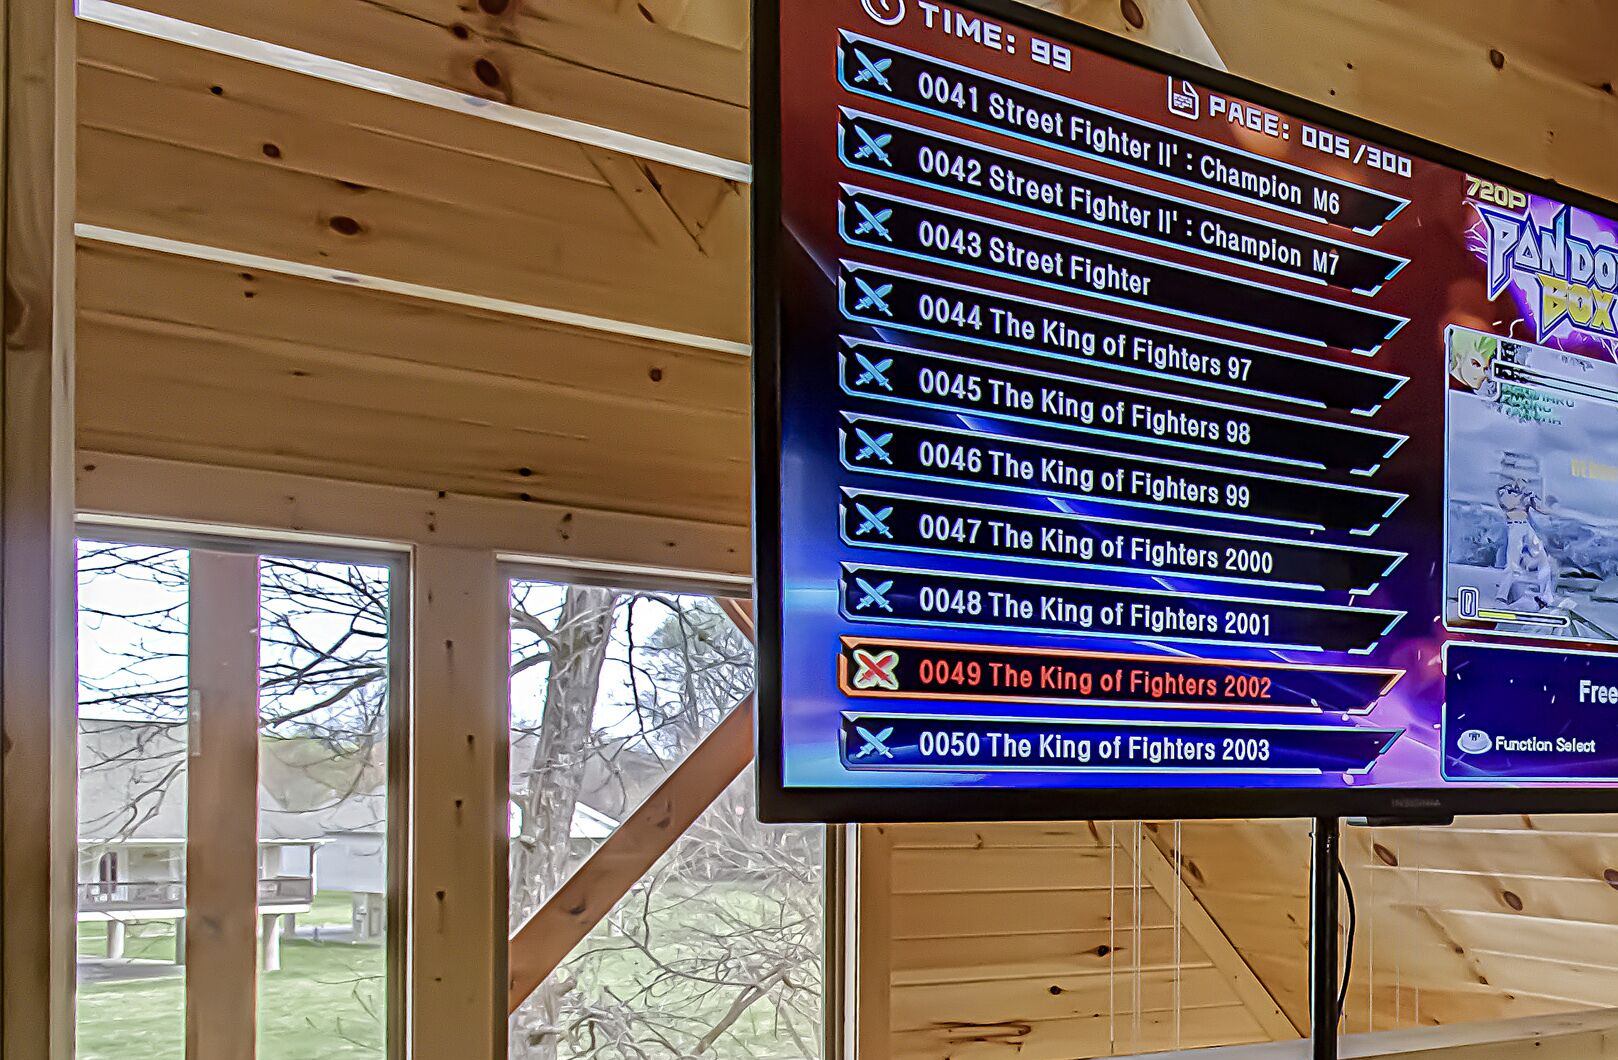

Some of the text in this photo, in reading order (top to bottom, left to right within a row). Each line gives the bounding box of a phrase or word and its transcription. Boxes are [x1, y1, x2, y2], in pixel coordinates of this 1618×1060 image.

[918, 1, 1071, 72] TIME: 99
[918, 72, 978, 113] 0041
[988, 92, 1064, 138] Street
[1071, 116, 1152, 161] Fighter
[1200, 155, 1302, 205] Champion
[1313, 187, 1340, 215] M6
[1209, 94, 1412, 178] PAGE: 005/300
[919, 146, 982, 187] 0042
[989, 165, 1064, 207] Street
[1071, 185, 1151, 229] Fighter
[1200, 220, 1301, 267] Champion
[1313, 249, 1340, 276] M7
[1466, 175, 1527, 209] 720P
[919, 220, 1151, 296] 0043 Street Fighter
[919, 294, 1252, 382] 0044 The King of Fighters 97
[1538, 275, 1618, 343] BOX
[919, 368, 1251, 445] 0045 The King of Fighters 98
[920, 441, 1250, 508] 0046 The King of Fighters 99
[919, 514, 1273, 574] 0047 The King of Fighters 2000
[919, 586, 1269, 636] 0048 The King of Fighters 2001
[919, 659, 1272, 699] 0049 The King of Fighters 2002
[1579, 679, 1618, 705] Free
[919, 731, 1270, 764] 0050 The King of Fighters 2003
[1495, 735, 1596, 753] Function Select
